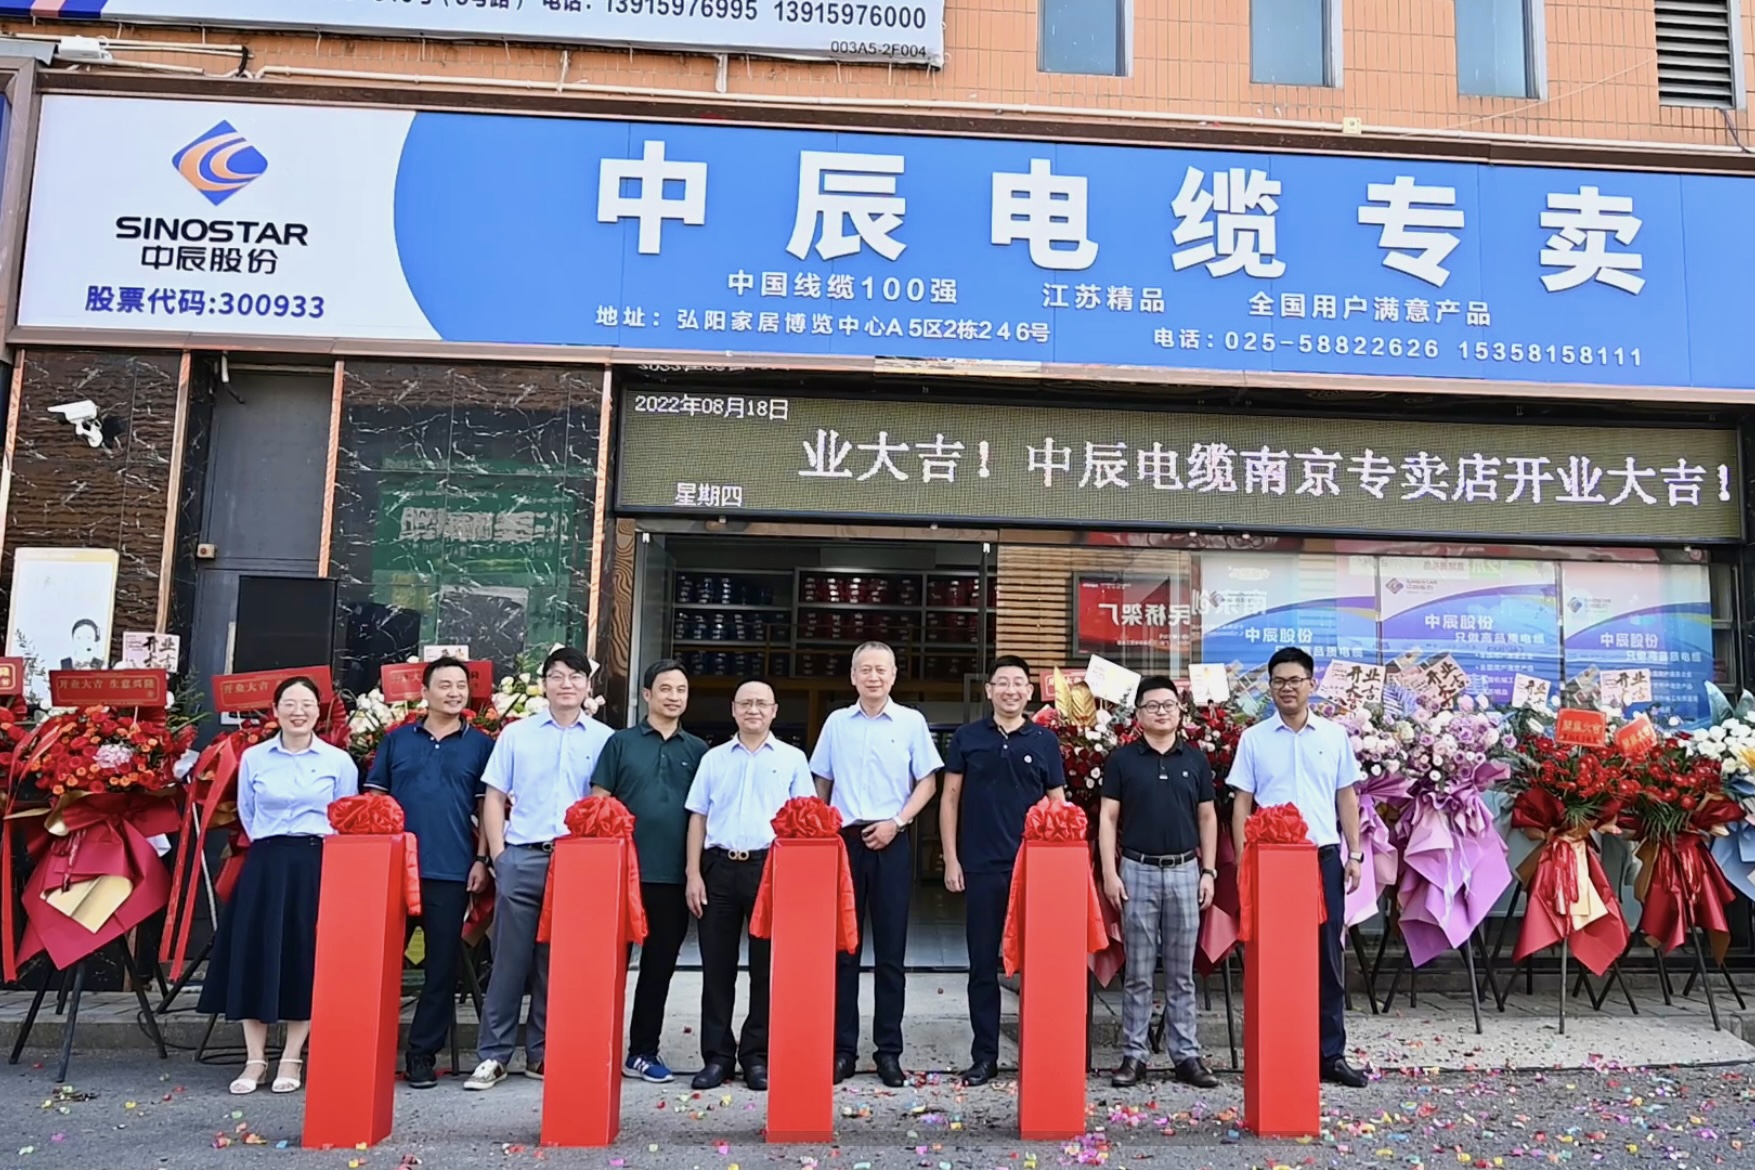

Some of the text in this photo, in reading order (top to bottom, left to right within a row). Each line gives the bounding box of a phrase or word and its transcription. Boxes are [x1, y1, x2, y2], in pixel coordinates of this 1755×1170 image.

[774, 1, 926, 28] 13915976000
[831, 41, 927, 58] 003A5-2F004
[115, 216, 309, 246] SINOSTAR
[596, 140, 1646, 296] 中辰电缆专卖
[141, 245, 279, 274] 中辰股份
[85, 285, 325, 319] 股票代码:300933
[727, 269, 1492, 328] 中国线缆100强 江苏精品 全国用户满意产品
[1458, 341, 1643, 367] 15358158111
[634, 393, 790, 421] 2022年08月18日
[674, 482, 743, 507] 星期四
[1245, 626, 1314, 644] 中辰股份
[1424, 613, 1495, 631] 中辰股份
[1600, 632, 1659, 649] 中辰股份
[1346, 665, 1381, 684] 开业
